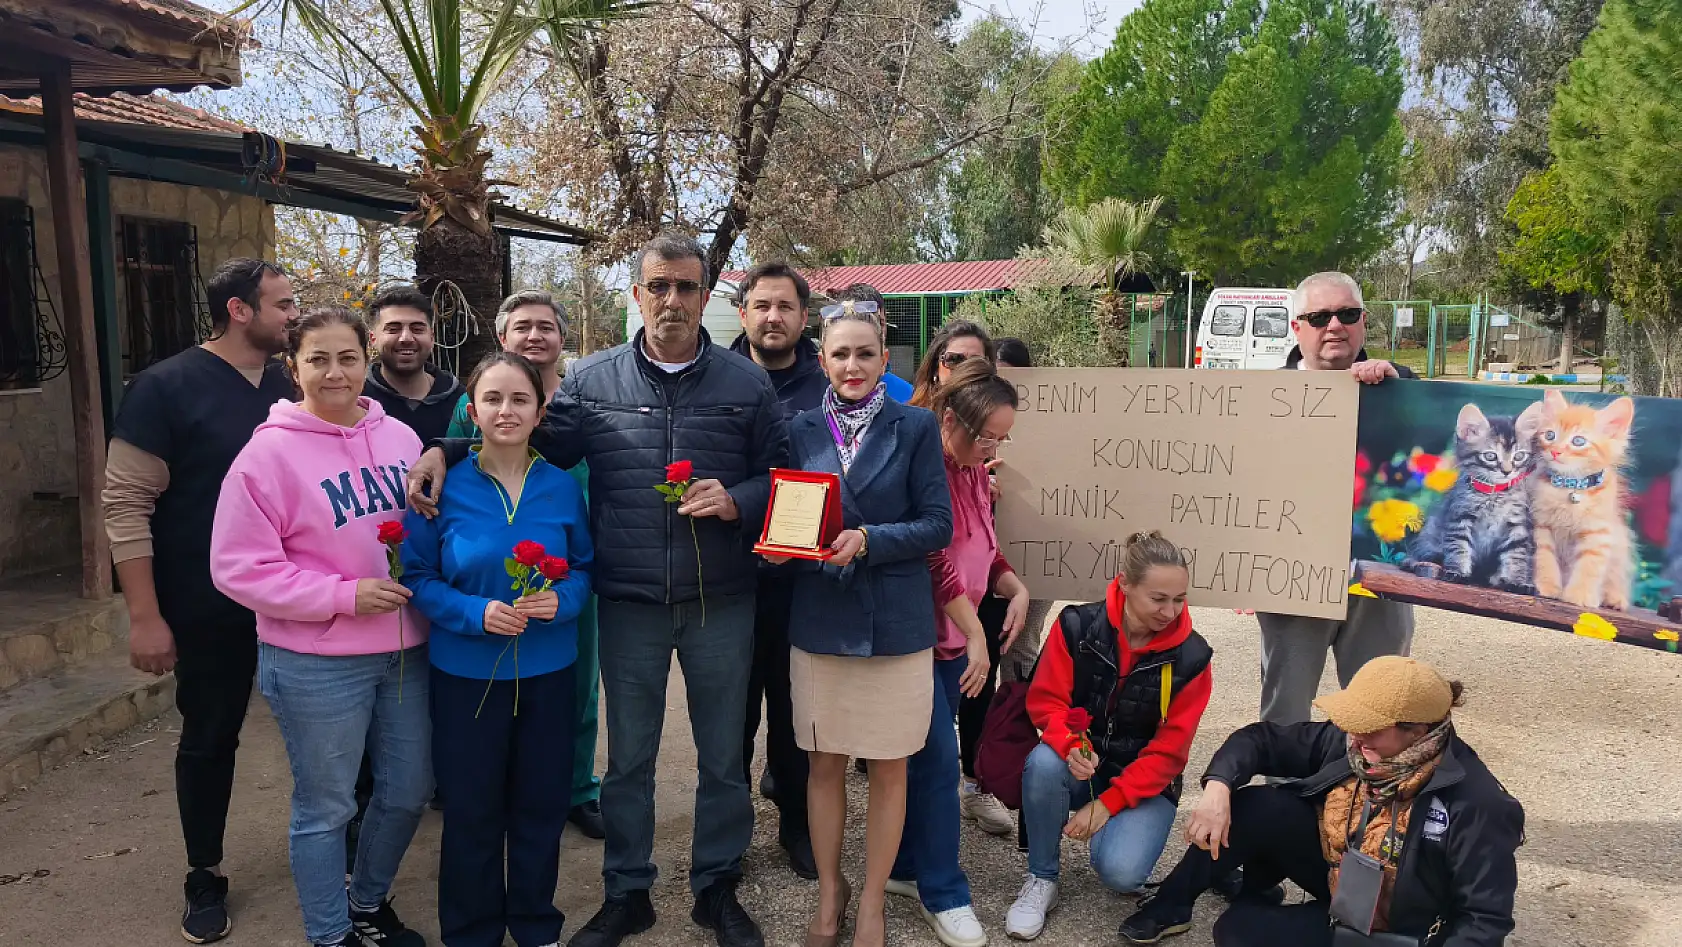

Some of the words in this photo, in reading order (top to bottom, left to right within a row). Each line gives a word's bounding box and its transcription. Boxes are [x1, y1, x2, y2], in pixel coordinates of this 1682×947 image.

[1015, 381, 1098, 413] BENİM
[1122, 381, 1243, 417] YERİME
[1269, 383, 1337, 418] SİZ
[1092, 438, 1235, 475] KONUŞUN
[320, 459, 409, 530] MAV
[1040, 484, 1125, 520] MİNİK
[1170, 492, 1303, 535] PATİLER
[1009, 537, 1077, 579] TEK
[1180, 547, 1347, 605] PLATFORMU
